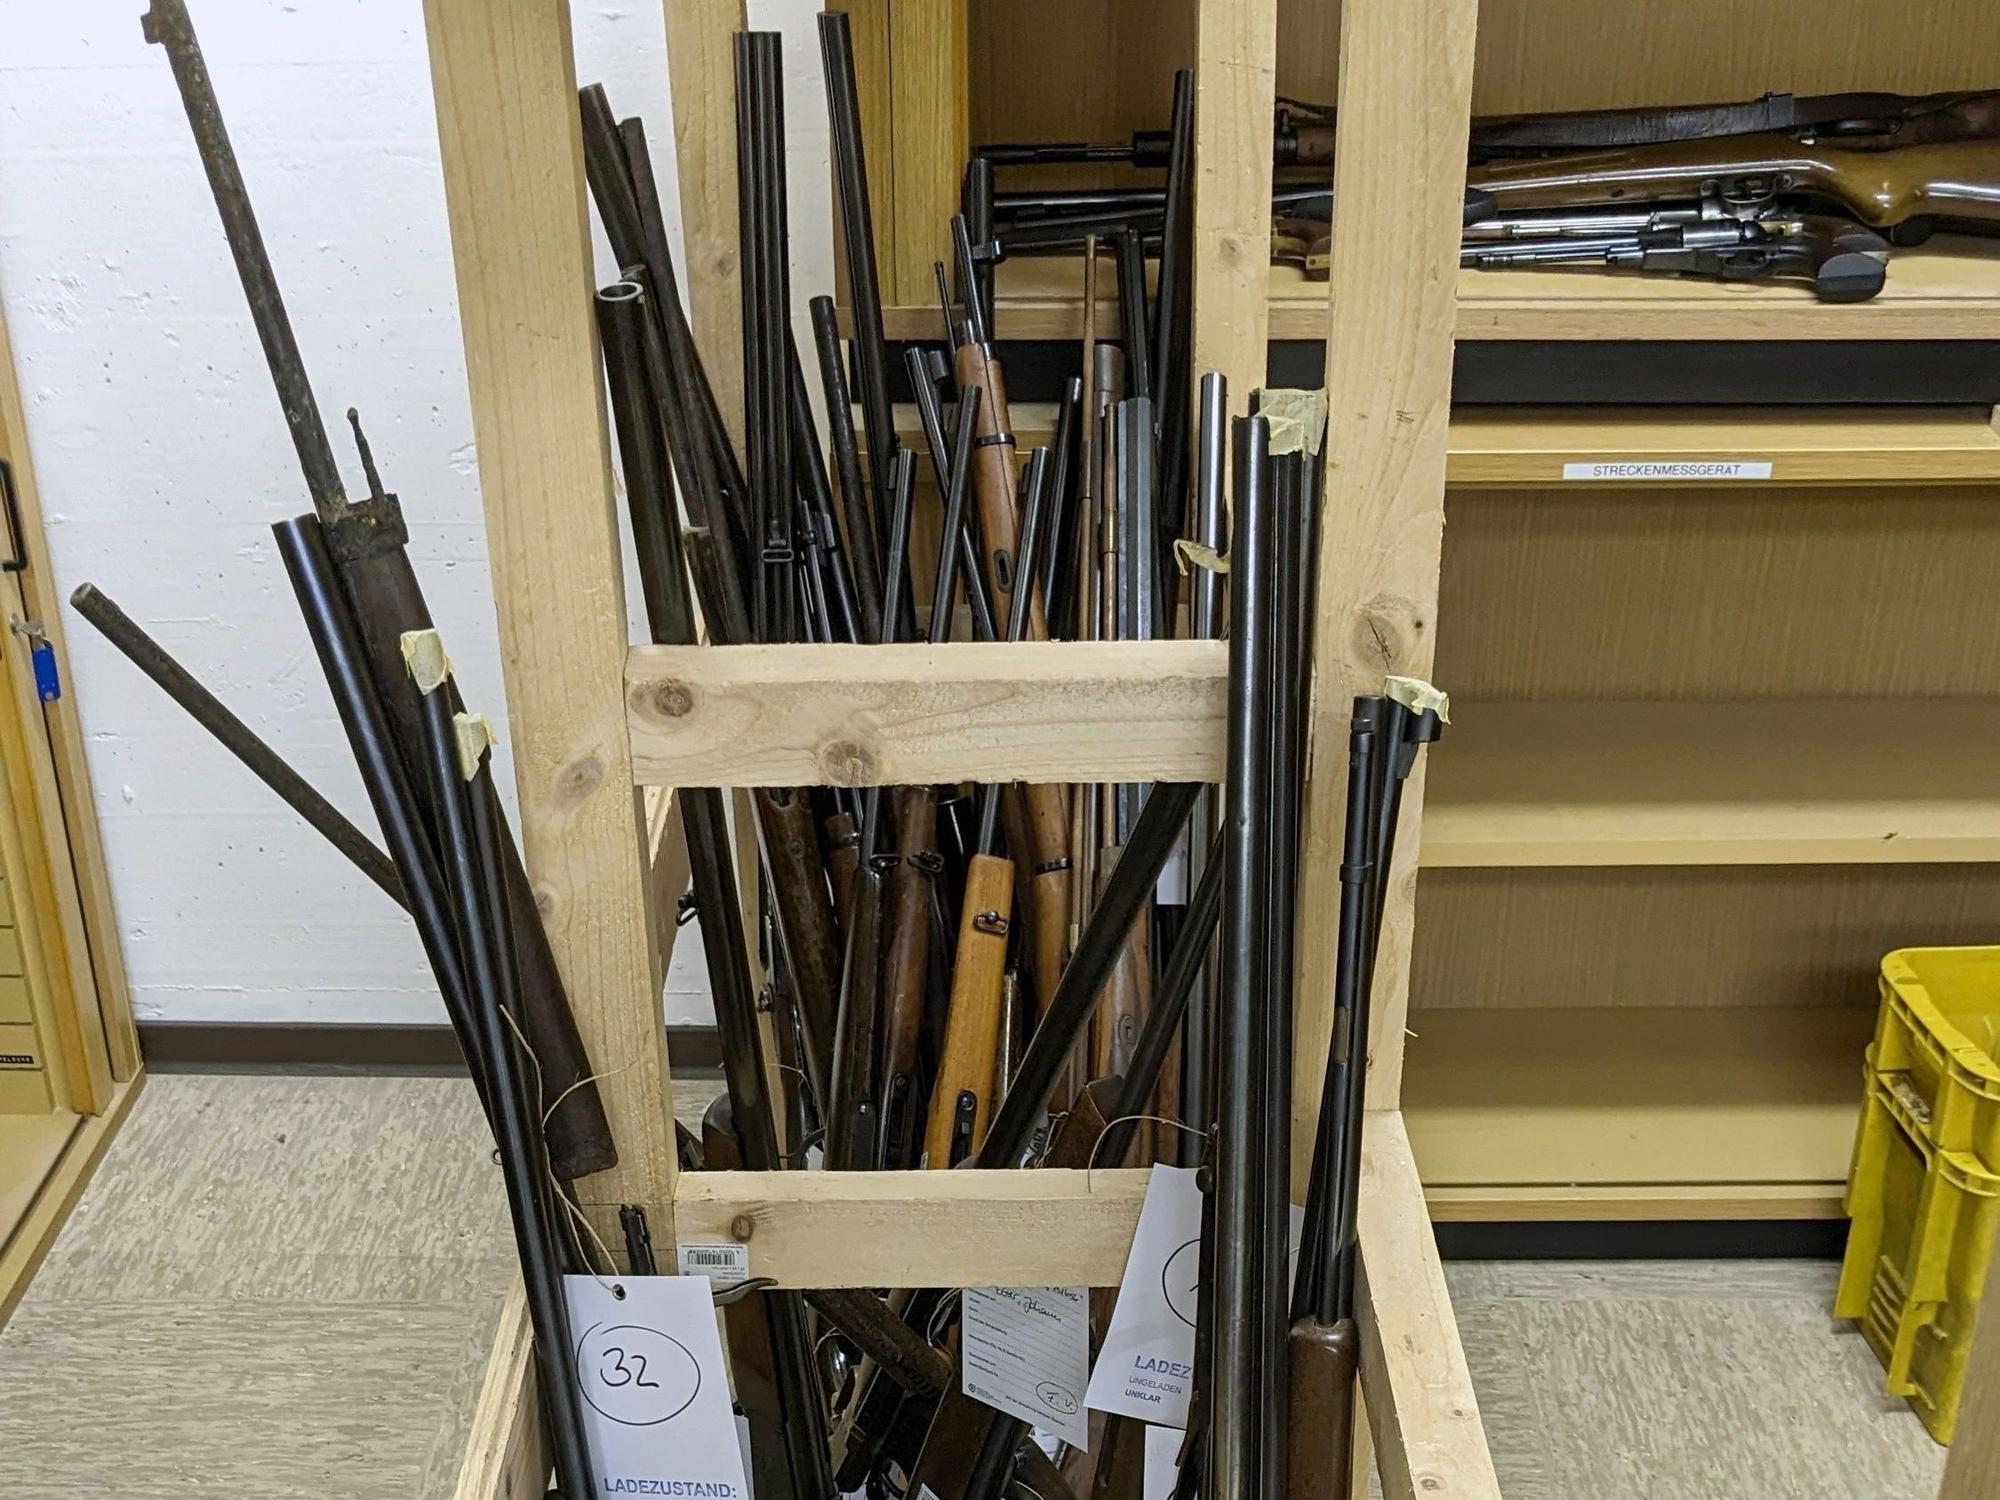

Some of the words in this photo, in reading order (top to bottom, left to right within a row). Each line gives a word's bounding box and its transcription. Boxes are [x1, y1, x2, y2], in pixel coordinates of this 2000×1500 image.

[600, 1347, 660, 1389] 32
[1129, 1376, 1182, 1395] UNGELADEN
[1125, 1389, 1161, 1404] UNKLAR
[604, 1477, 737, 1499] LADEZUSTAND:
